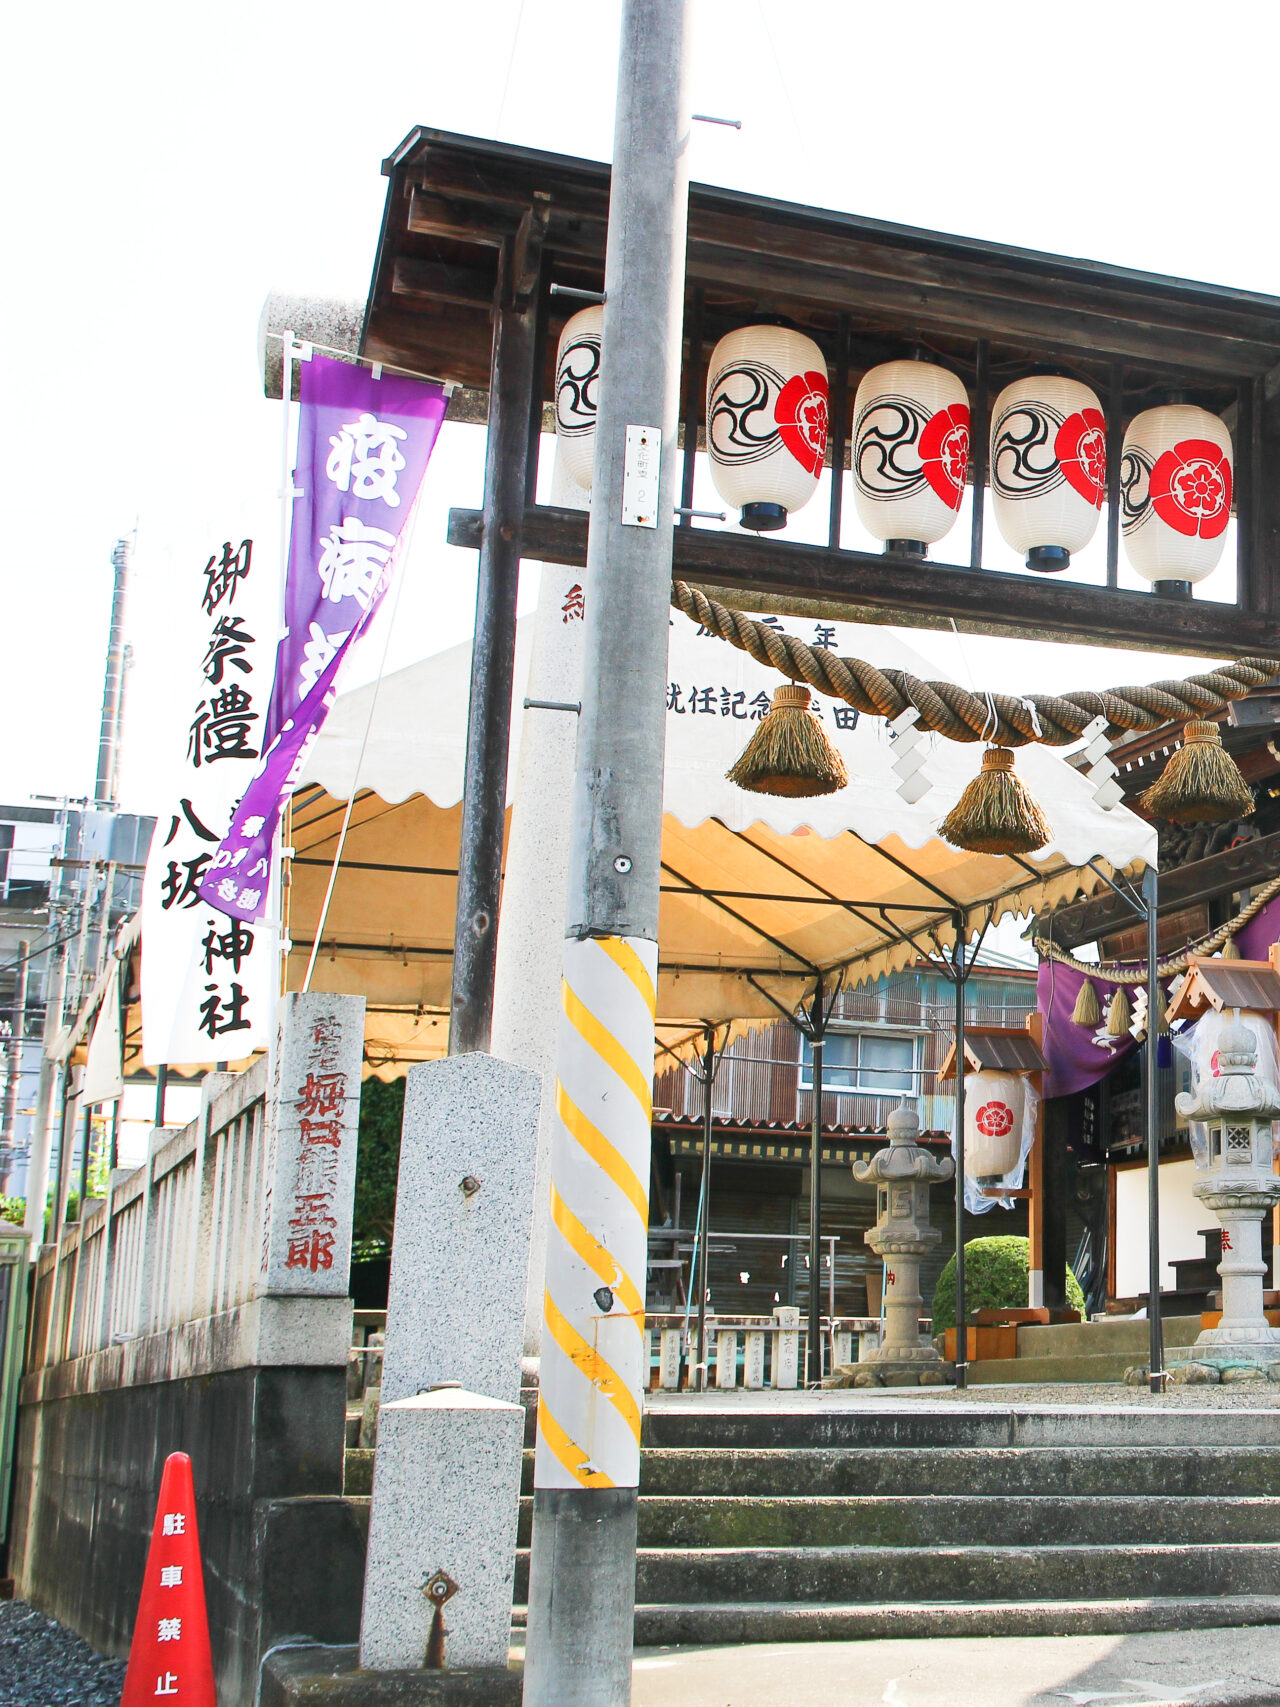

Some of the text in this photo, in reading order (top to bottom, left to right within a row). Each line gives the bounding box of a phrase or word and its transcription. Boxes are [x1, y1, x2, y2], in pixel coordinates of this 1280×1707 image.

[187, 538, 259, 768] 御祭禮
[154, 1512, 186, 1696] 駐車禁止
